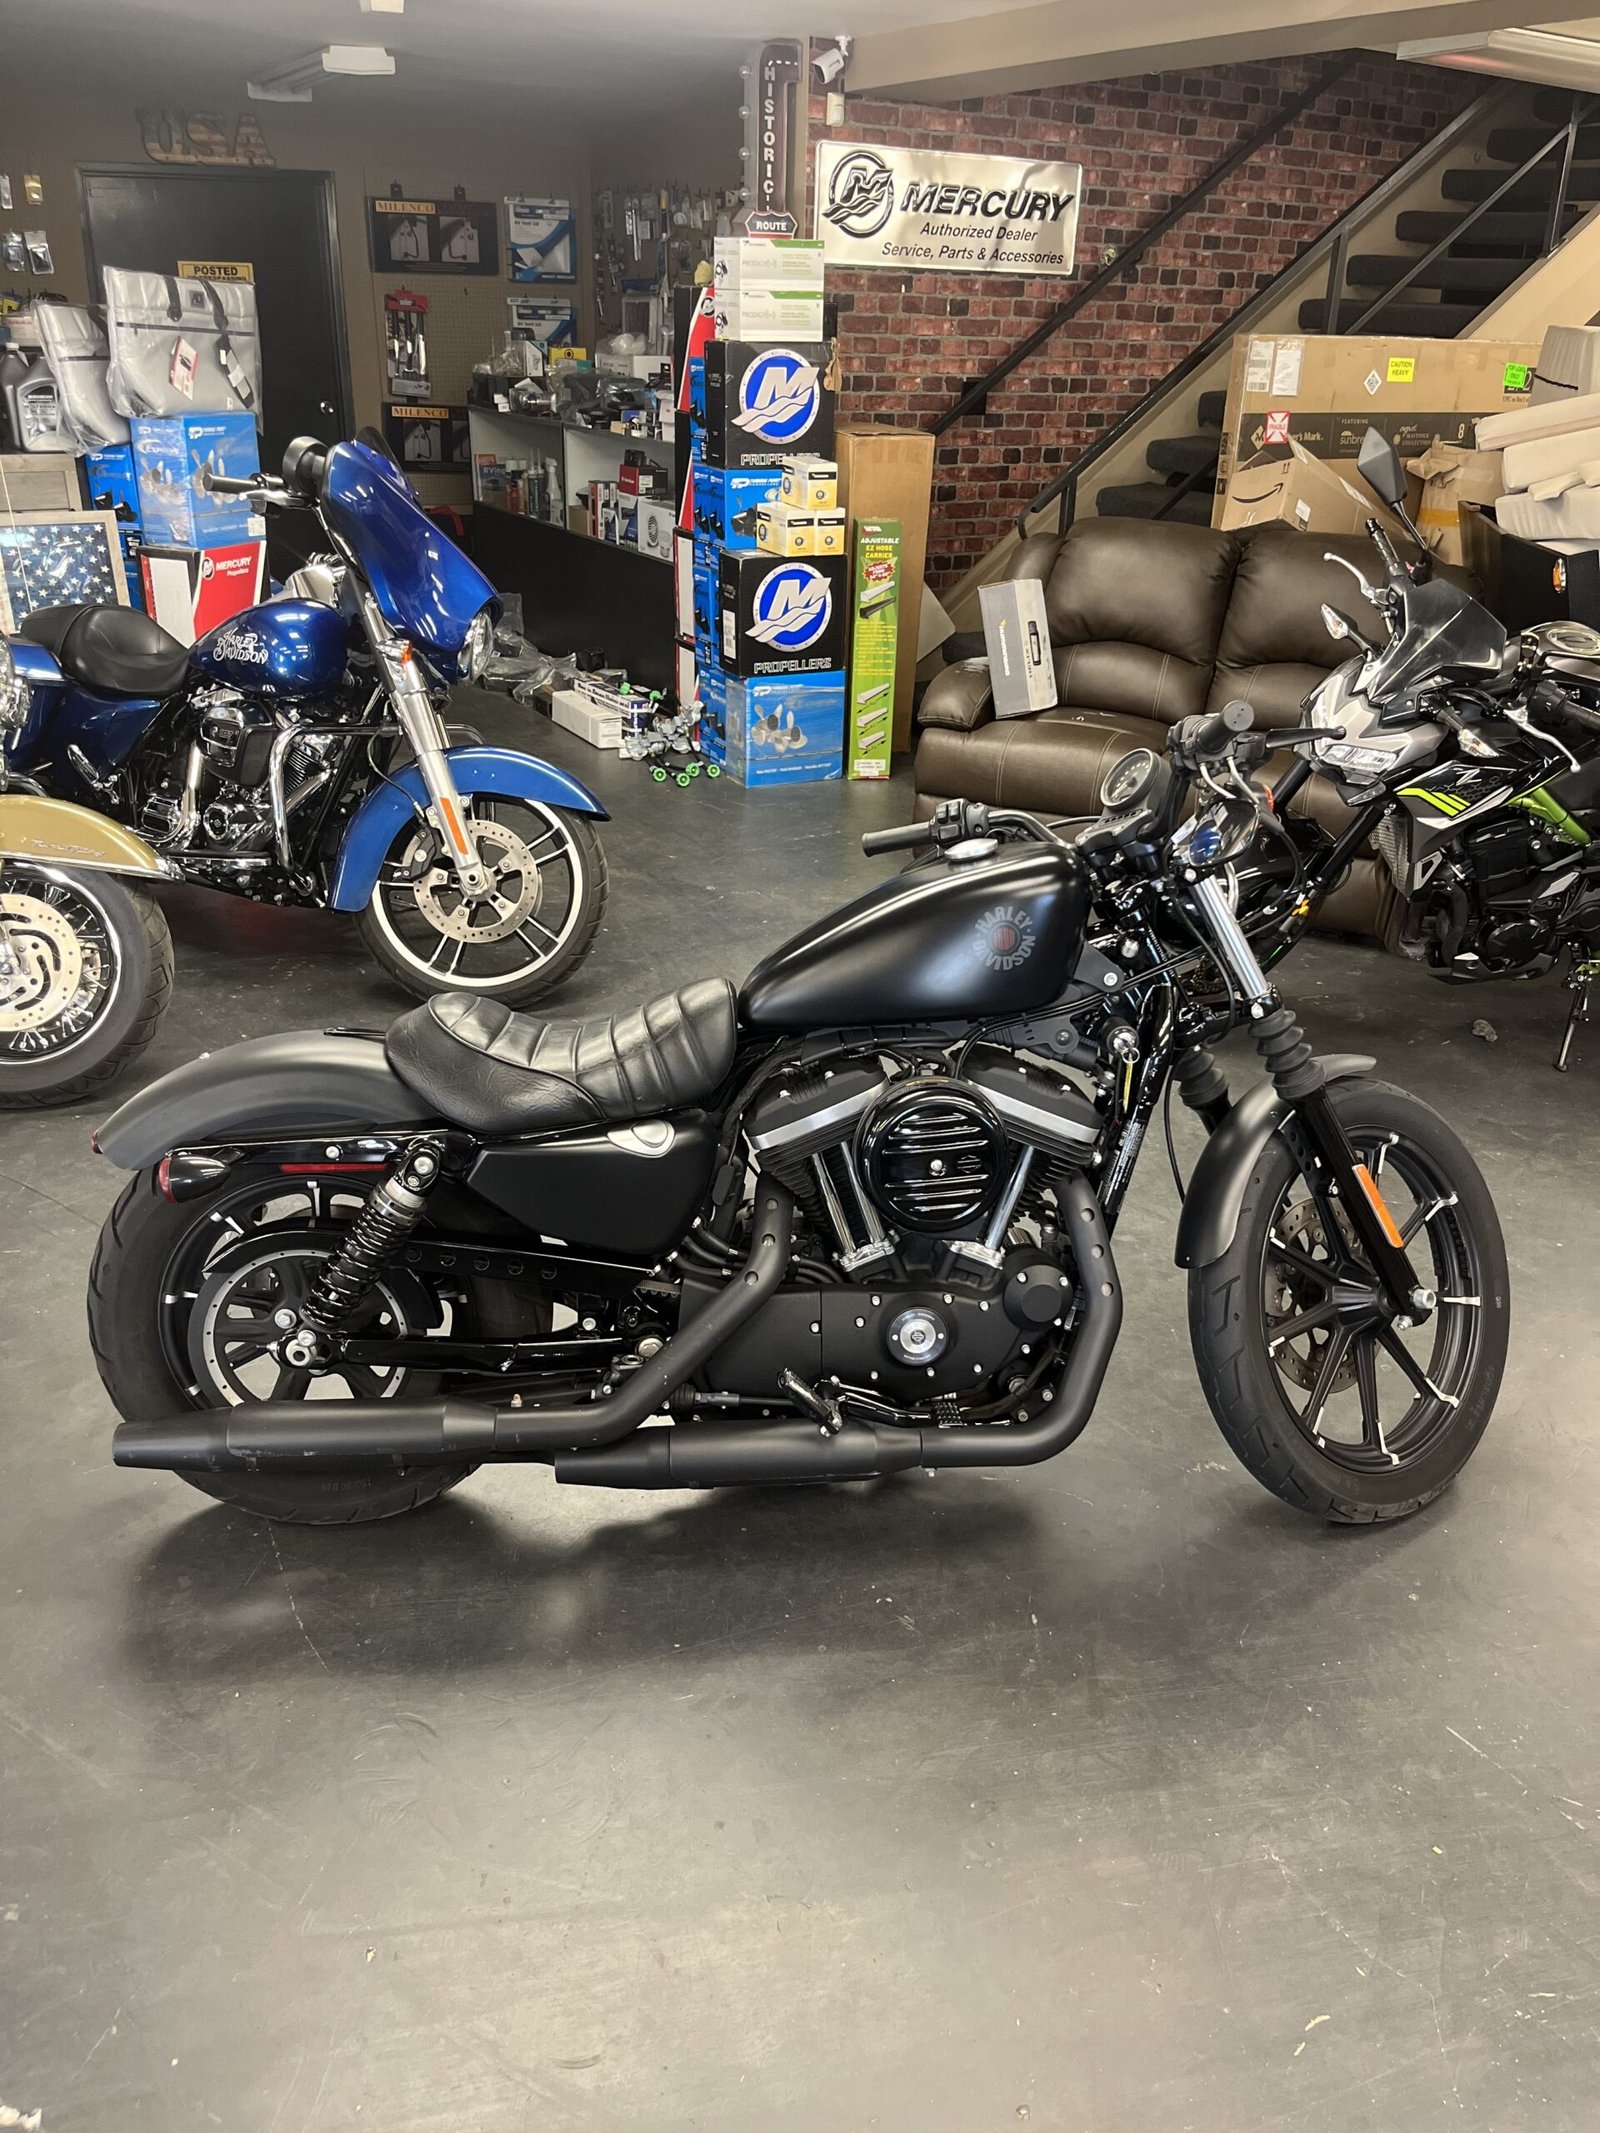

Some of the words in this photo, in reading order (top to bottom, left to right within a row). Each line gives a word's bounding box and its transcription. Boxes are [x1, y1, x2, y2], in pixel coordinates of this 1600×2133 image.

[135, 106, 276, 168] USA
[763, 67, 776, 194] HISTORIC
[377, 201, 436, 213] MILENCO
[899, 182, 1075, 222] MERCURY
[756, 221, 787, 231] ROUTE
[919, 222, 993, 239] Authorized
[996, 227, 1039, 241] Dealer
[881, 242, 934, 260] Service,
[938, 245, 974, 260] Parts
[976, 250, 986, 260] &
[991, 250, 1064, 265] Accessories
[194, 266, 238, 276] POSTED
[1390, 360, 1413, 369] CAUTION
[1391, 368, 1410, 376] HEAVY
[393, 407, 448, 417] MILENCO
[1458, 423, 1465, 439] 8
[216, 557, 252, 571] MERCURY
[753, 657, 832, 674] PROPELLERS
[974, 906, 1033, 934] HARLEY
[972, 935, 1036, 970] DAVIDSON
